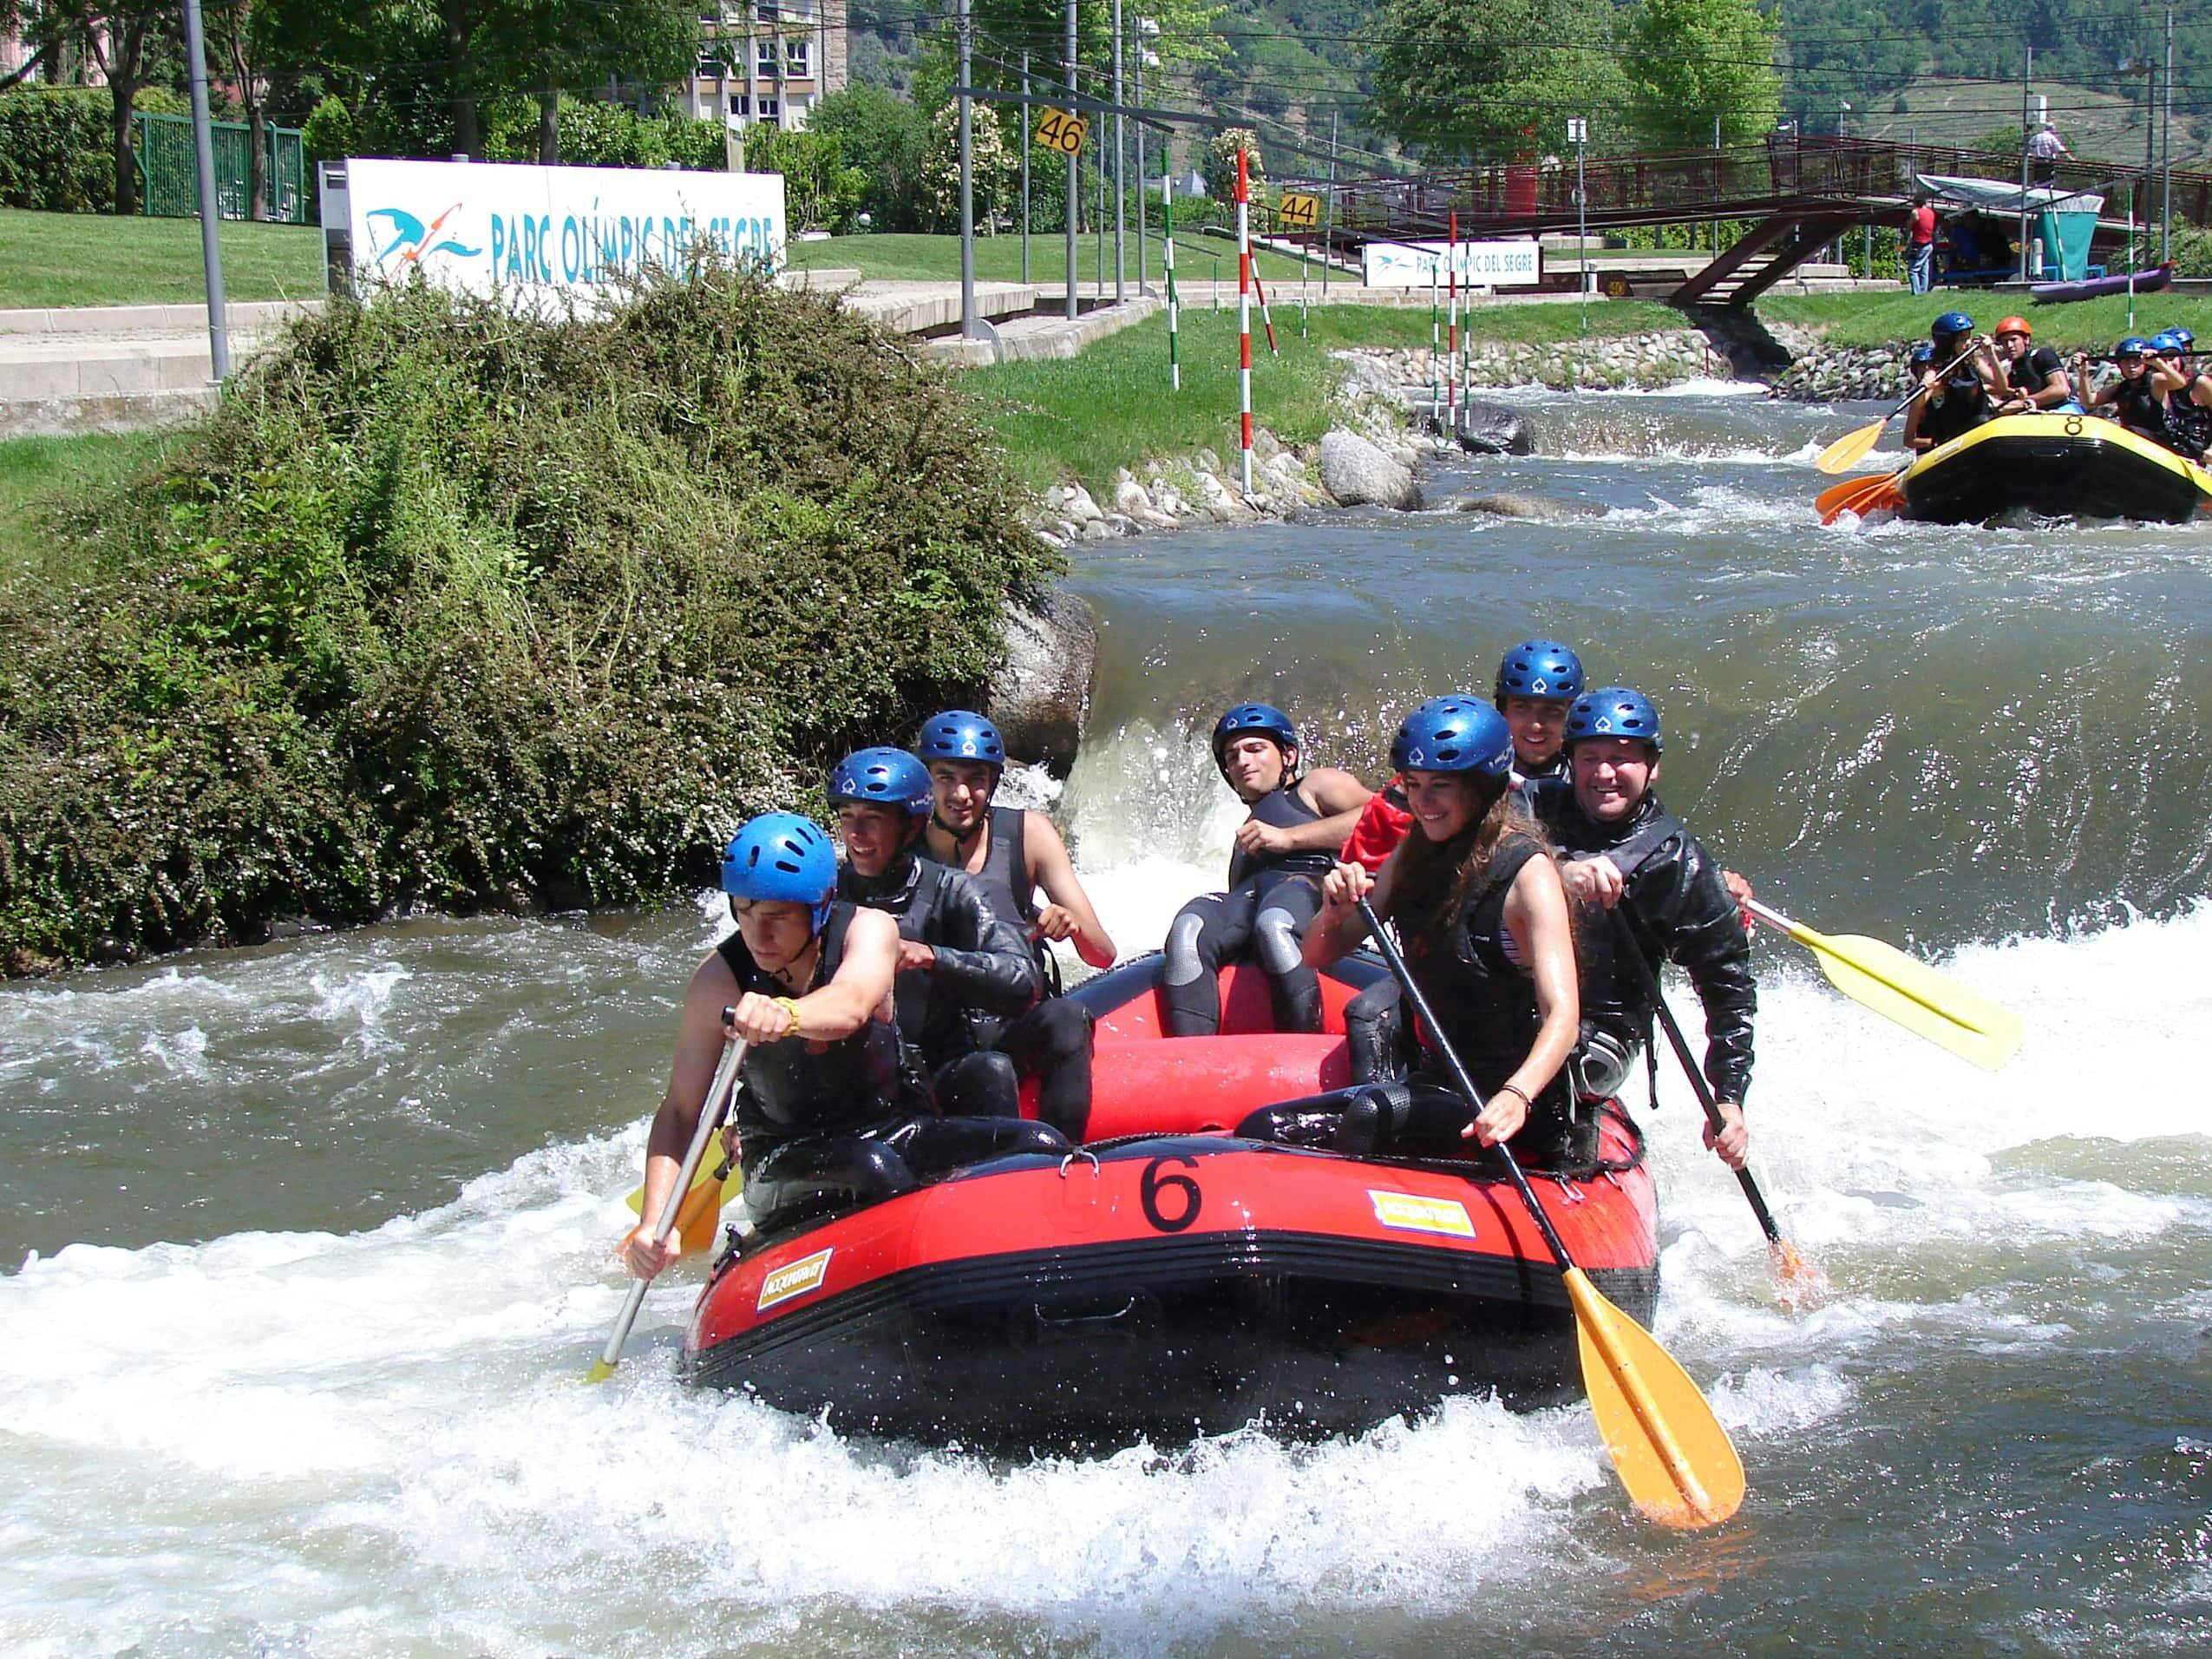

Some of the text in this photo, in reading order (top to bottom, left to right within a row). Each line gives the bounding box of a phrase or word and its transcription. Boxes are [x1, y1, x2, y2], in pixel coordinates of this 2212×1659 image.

[1039, 115, 1085, 152] 46
[1281, 197, 1314, 222] 44
[491, 213, 552, 285] PARC
[1417, 255, 1440, 273] PARC
[1484, 254, 1501, 272] DEL
[1504, 253, 1532, 272] SEGRE
[2065, 415, 2082, 436] 8
[1140, 1155, 1201, 1233] 6
